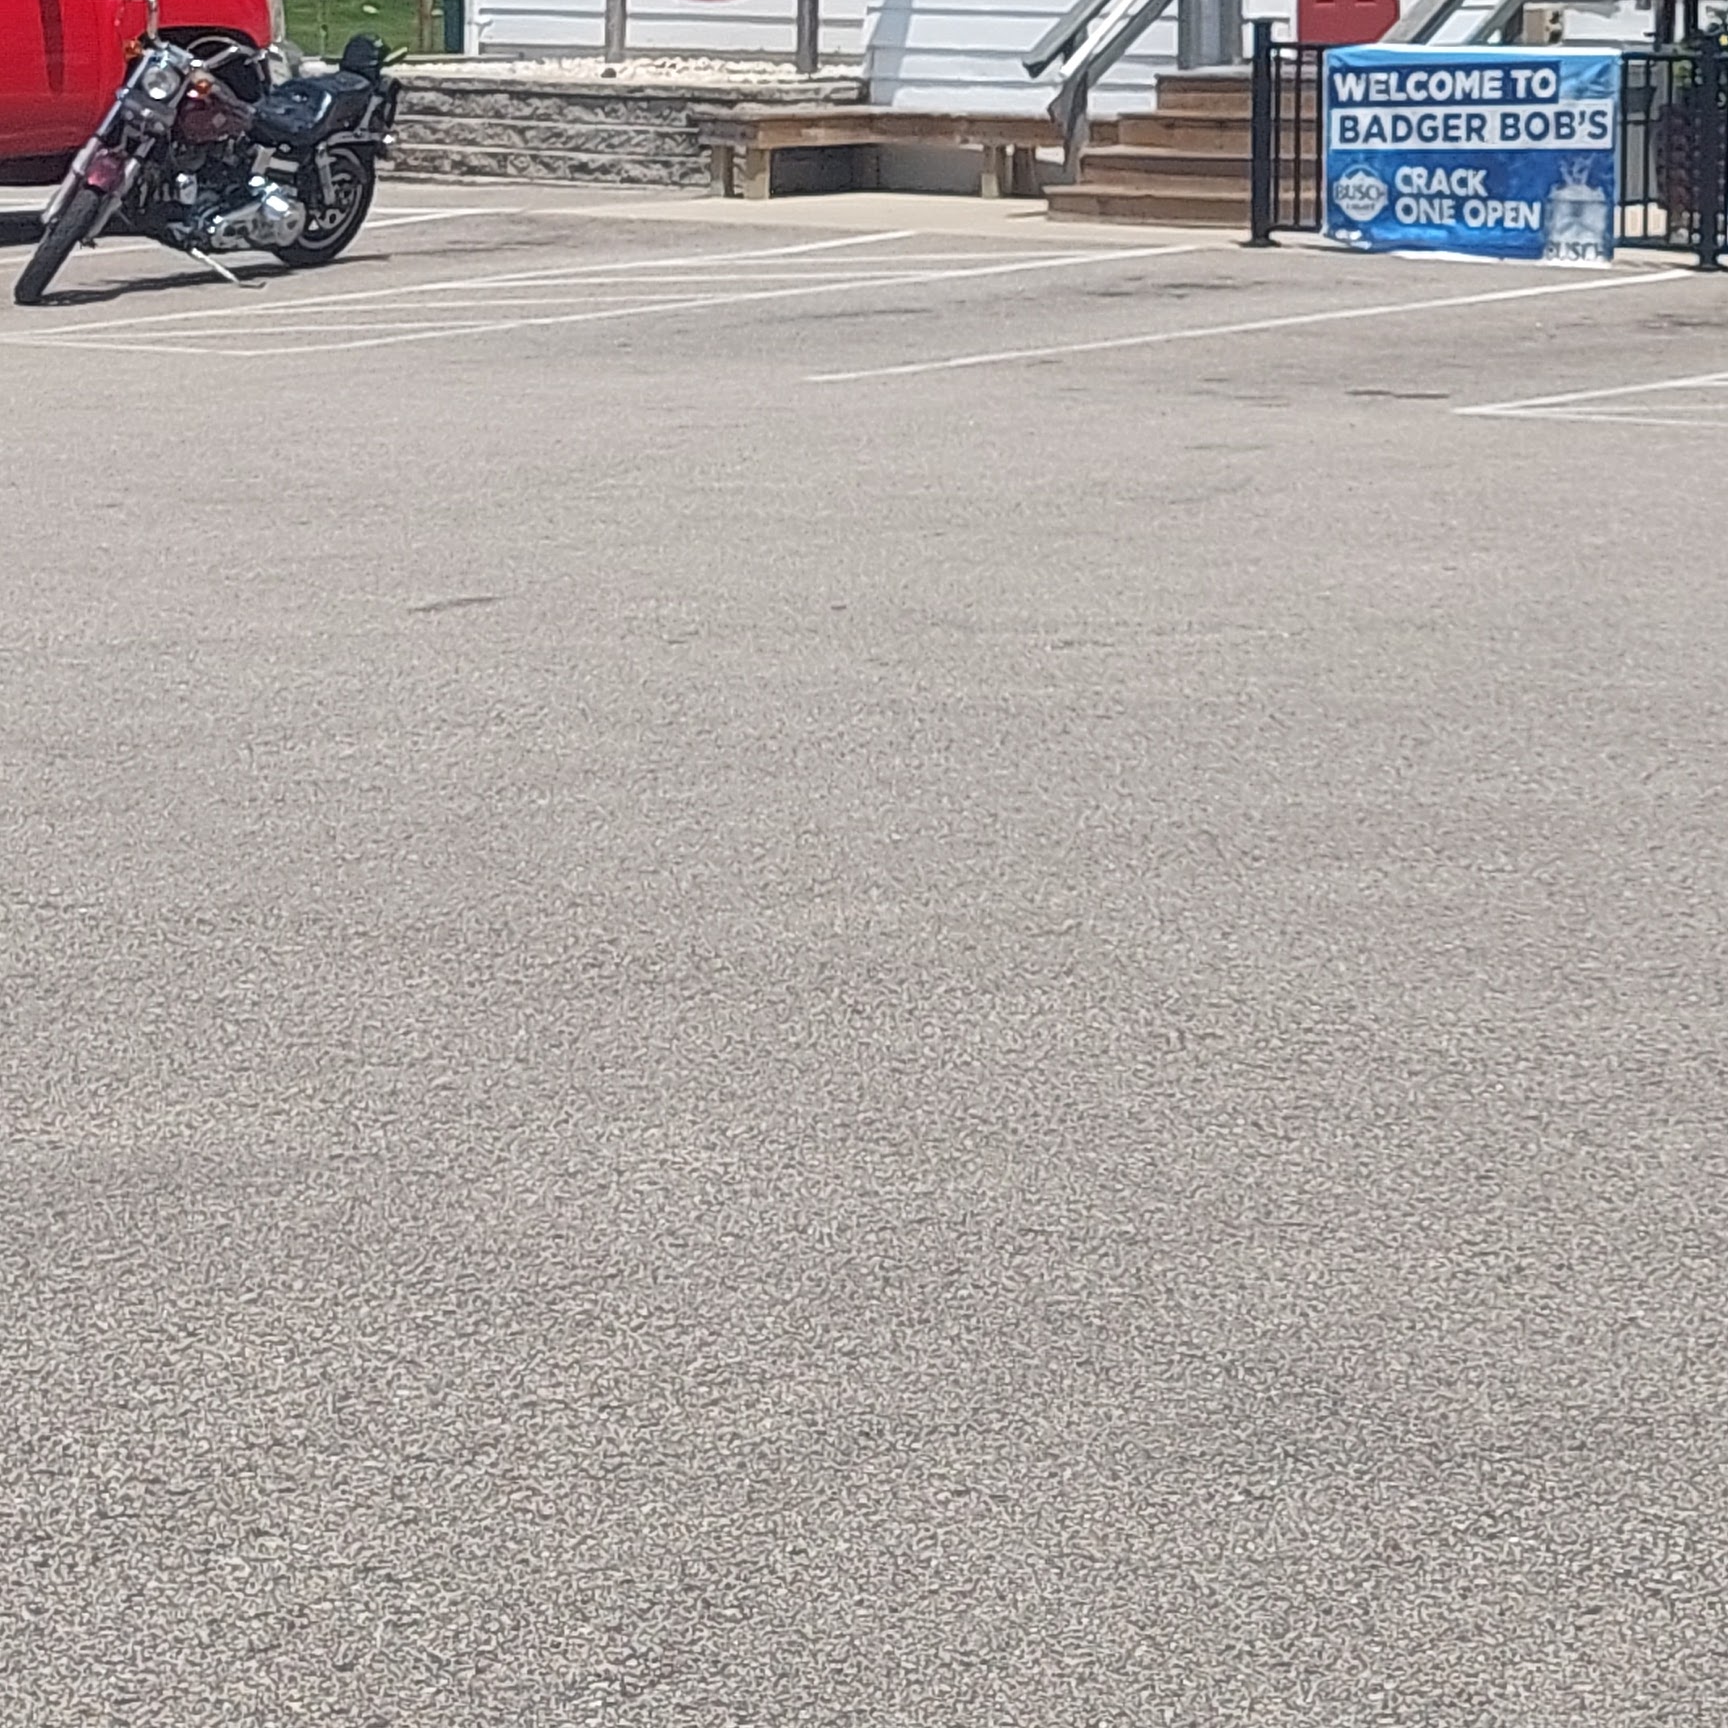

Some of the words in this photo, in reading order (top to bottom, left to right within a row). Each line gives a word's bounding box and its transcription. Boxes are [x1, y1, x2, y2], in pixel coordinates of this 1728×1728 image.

[1334, 70, 1503, 101] WELCOME
[1511, 69, 1557, 98] TO
[1338, 113, 1486, 143] BADGER
[1500, 109, 1608, 141] BOB'S
[1395, 166, 1488, 197] CRACK
[1395, 198, 1455, 224] ONE
[1463, 201, 1541, 230] OPEN
